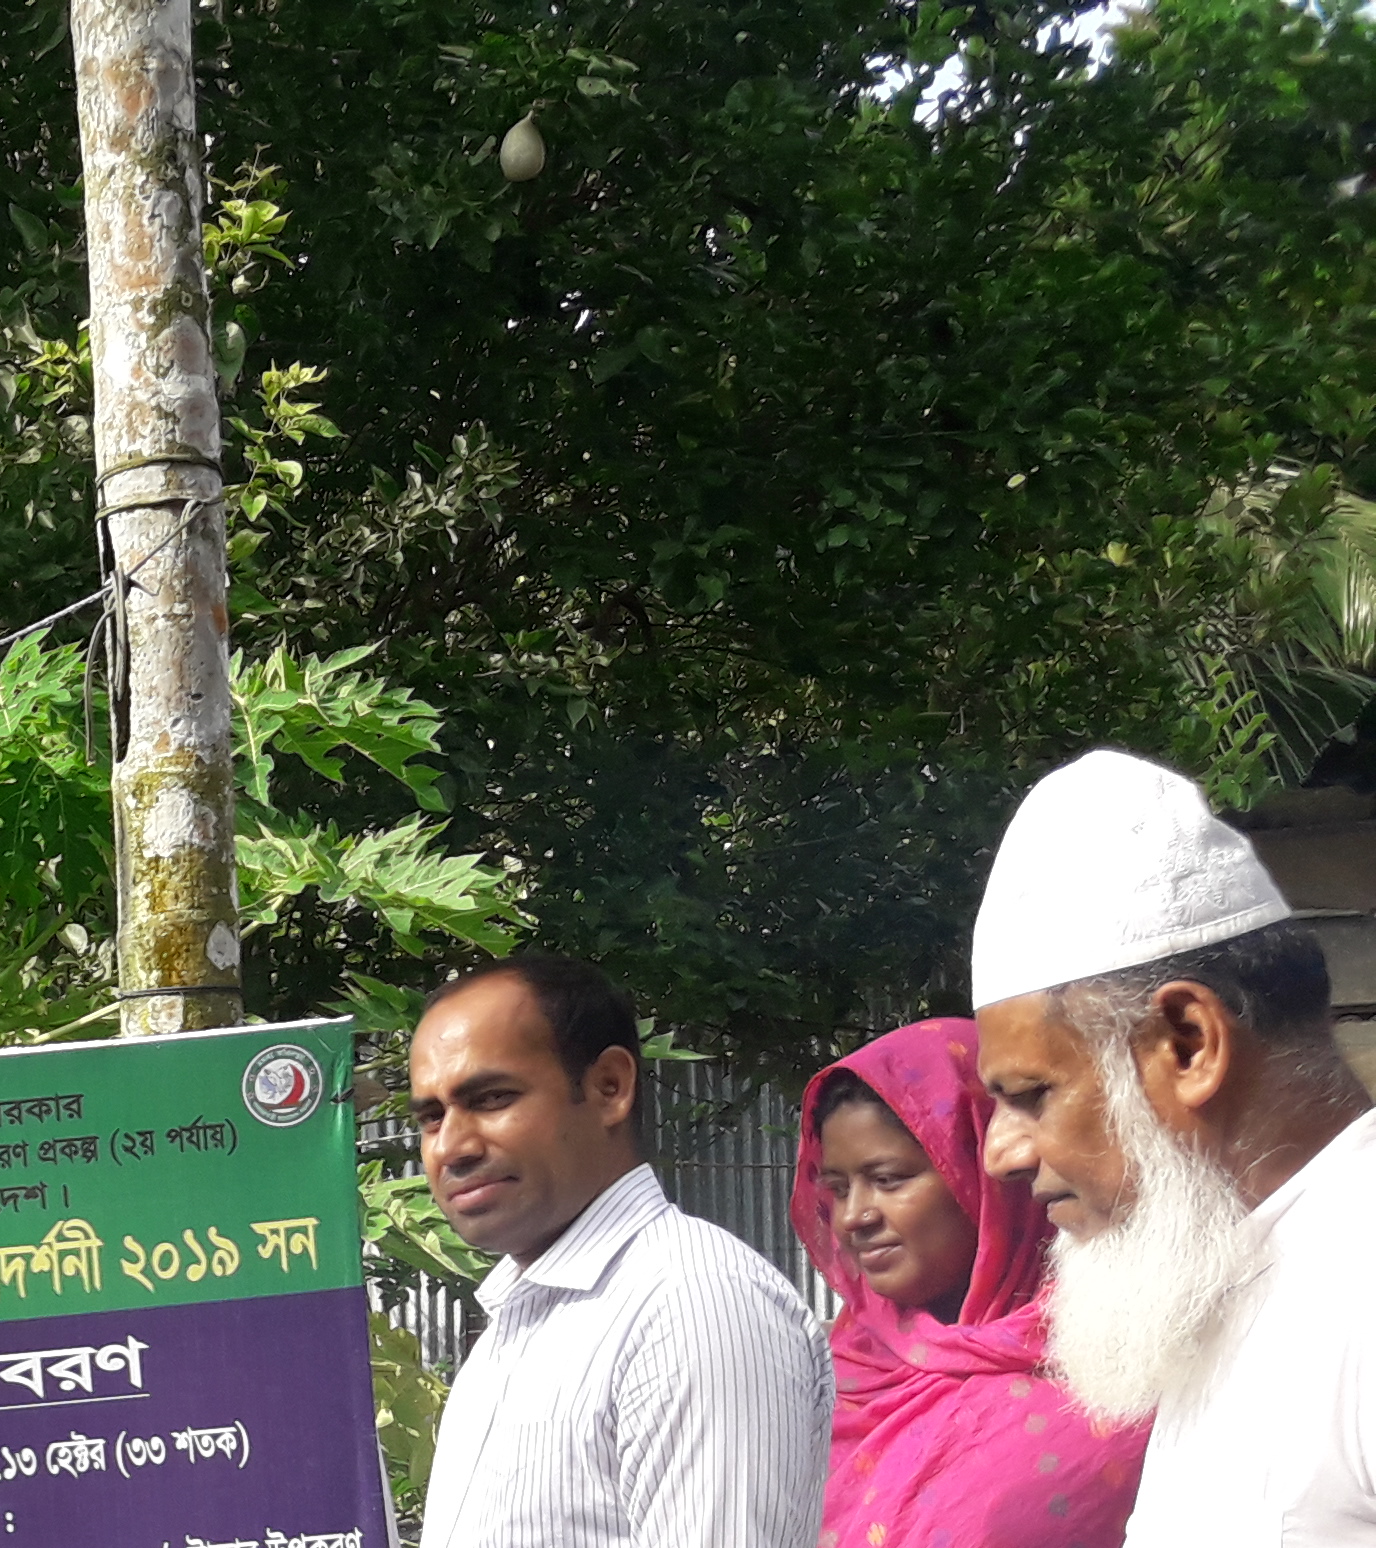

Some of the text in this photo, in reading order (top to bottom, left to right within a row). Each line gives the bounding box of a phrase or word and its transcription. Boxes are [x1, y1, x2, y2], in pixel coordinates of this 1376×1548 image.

[37, 1133, 100, 1166] প্রকল্প
[109, 1126, 157, 1167] (২য়
[165, 1114, 240, 1156] পর্যায়)
[118, 1225, 242, 1294] ২০১৯
[248, 1216, 321, 1274] সন
[45, 1430, 108, 1480] হেক্টর
[114, 1429, 167, 1480] (৩৩
[172, 1419, 252, 1471] শতক)
